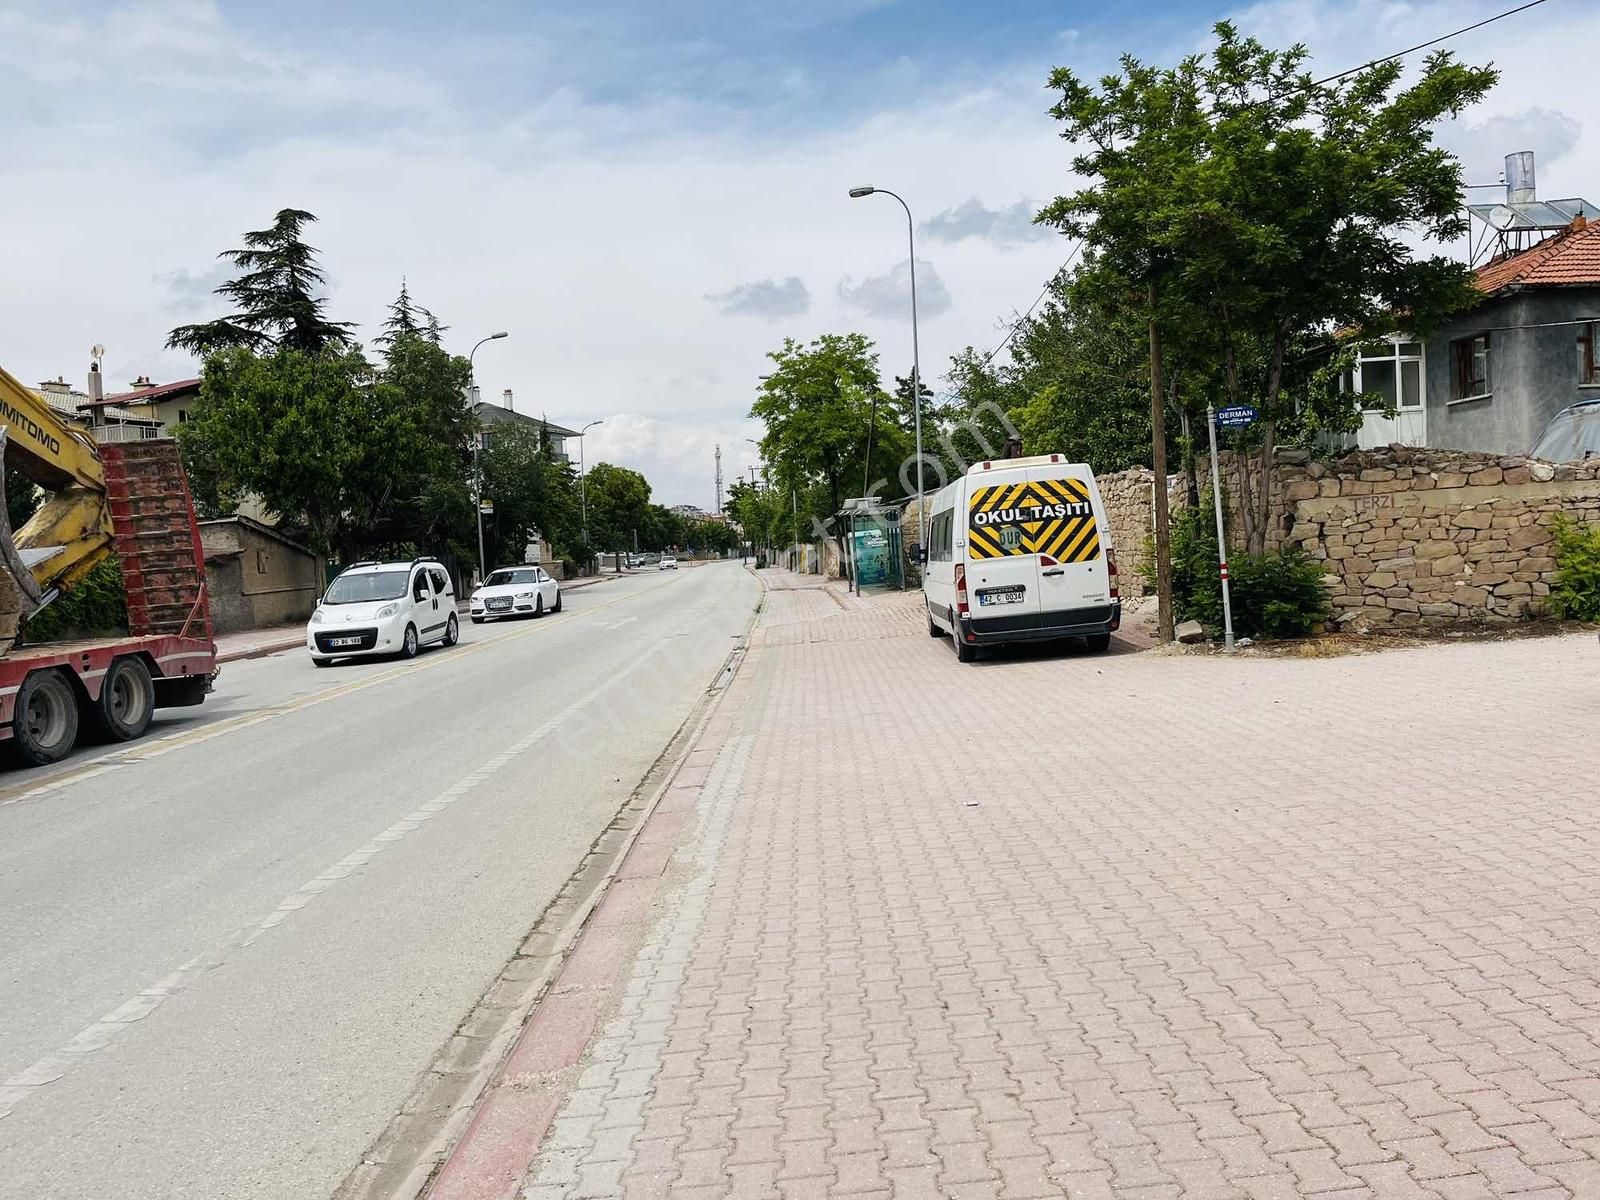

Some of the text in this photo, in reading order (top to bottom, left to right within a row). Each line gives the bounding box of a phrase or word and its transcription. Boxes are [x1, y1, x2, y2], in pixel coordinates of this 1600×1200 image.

[1219, 410, 1253, 419] DERMAN
[974, 501, 1090, 525] OKUL TAŞITI
[1000, 531, 1021, 546] DUR
